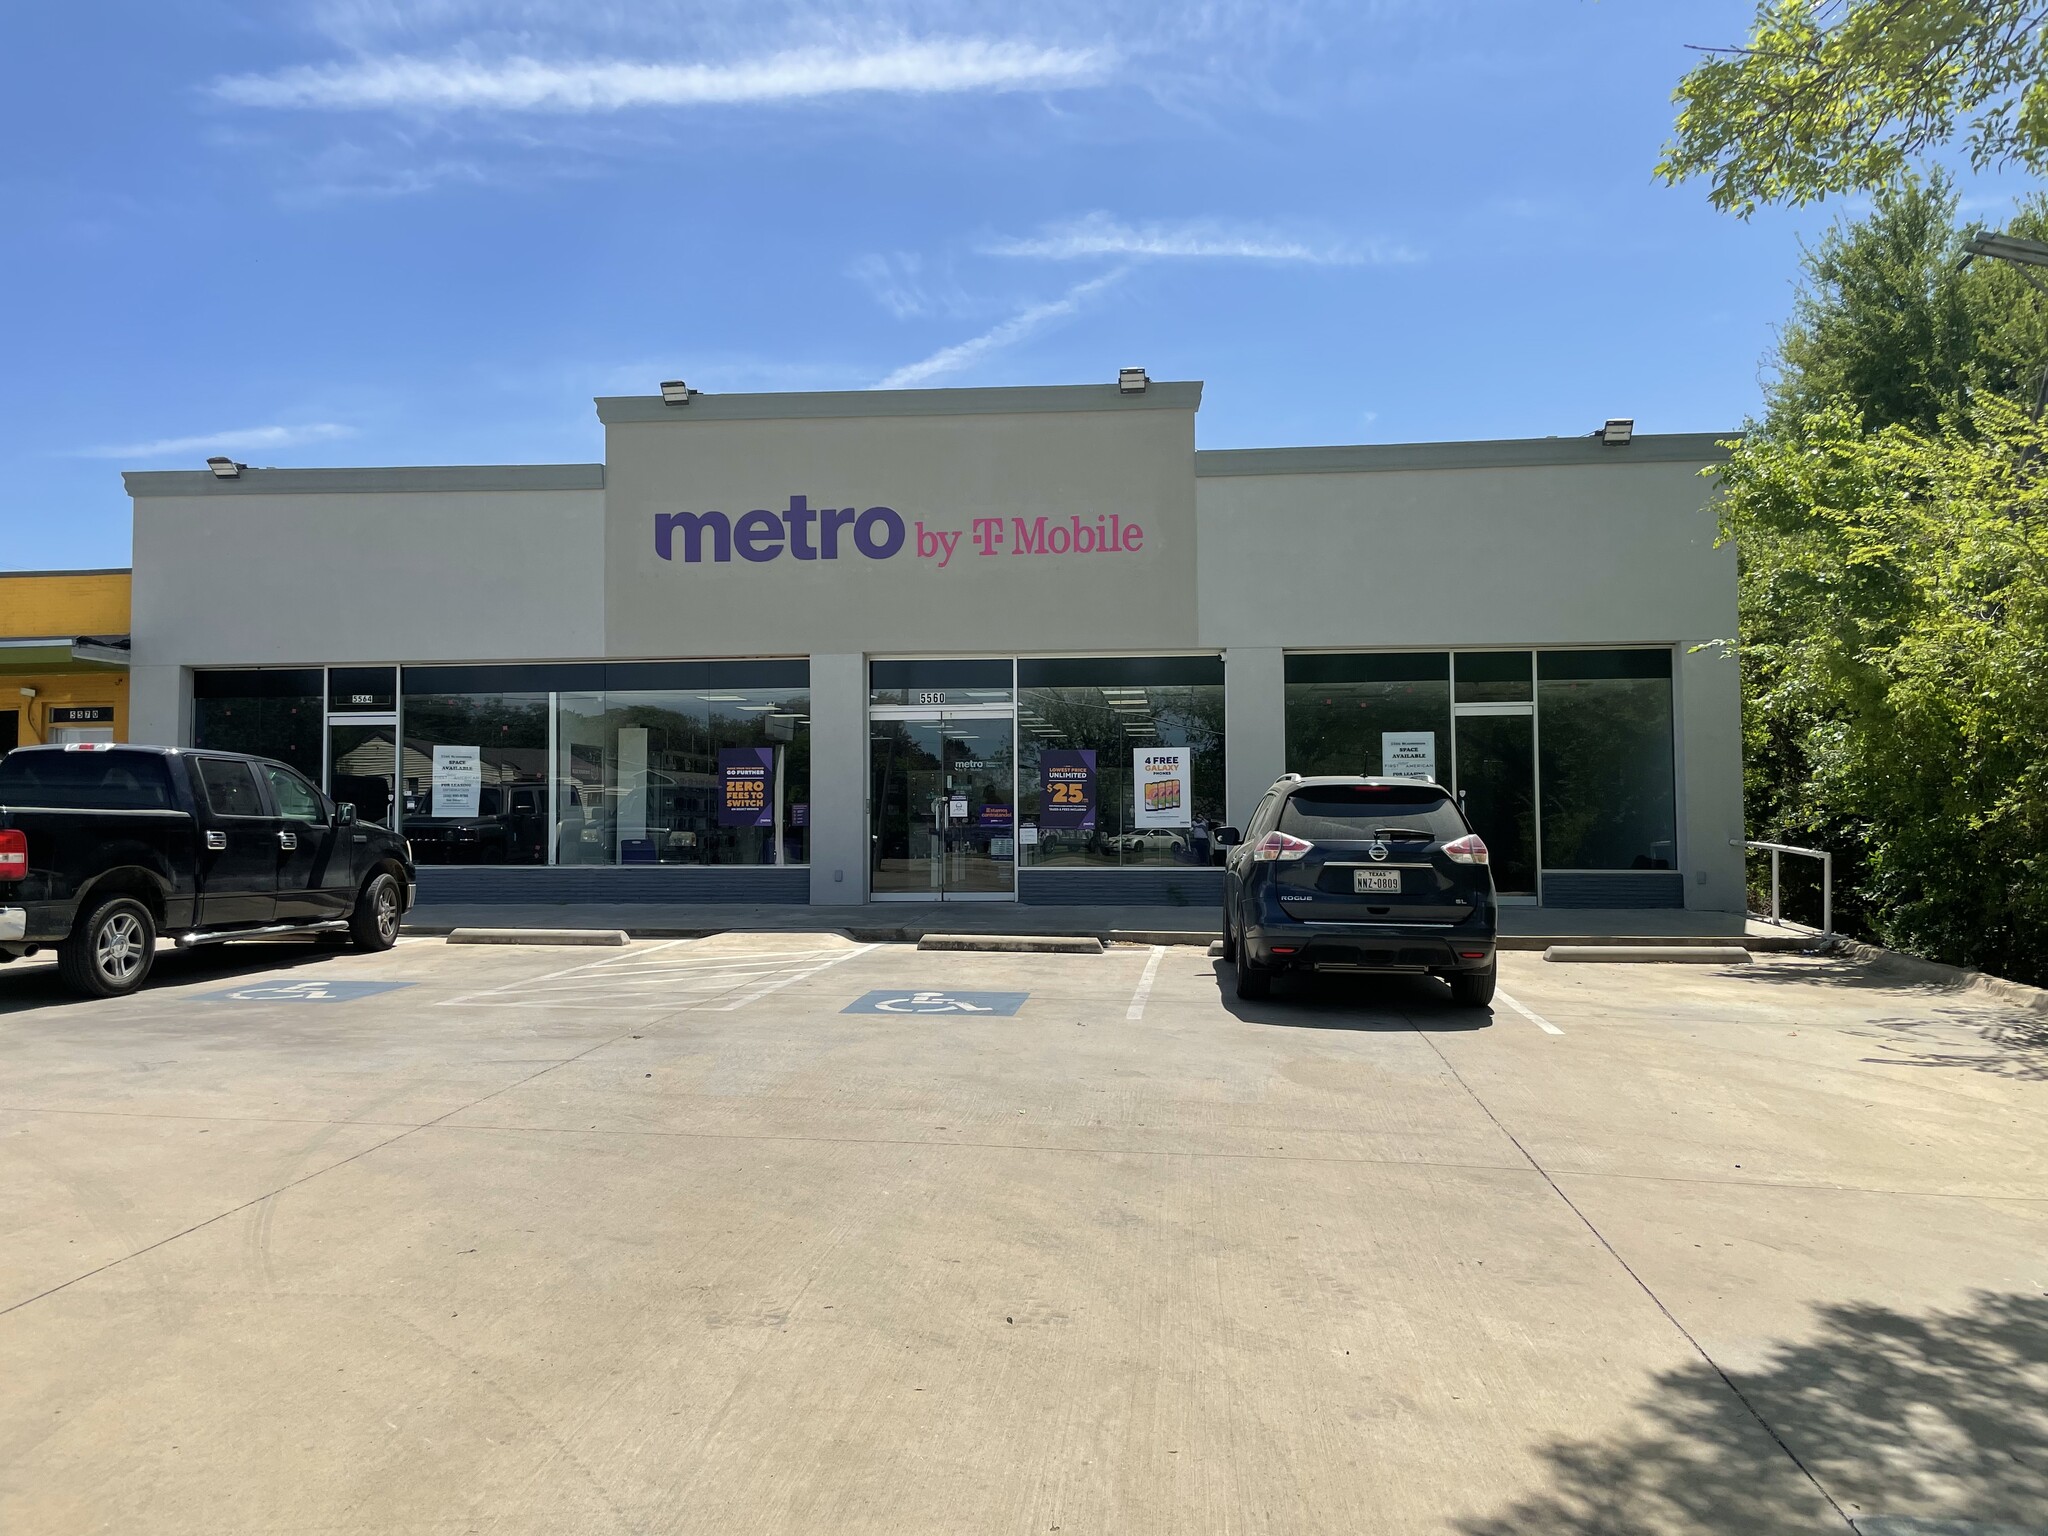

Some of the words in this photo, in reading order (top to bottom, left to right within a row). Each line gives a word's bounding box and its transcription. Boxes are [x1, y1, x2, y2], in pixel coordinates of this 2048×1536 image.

[655, 495, 905, 562] metro
[914, 521, 962, 567] by
[920, 693, 945, 704] 5560
[955, 760, 983, 769] metro
[1145, 756, 1151, 764] 4
[1152, 756, 1178, 764] FREE
[726, 781, 764, 792] ZERO
[1046, 783, 1084, 803] $25
